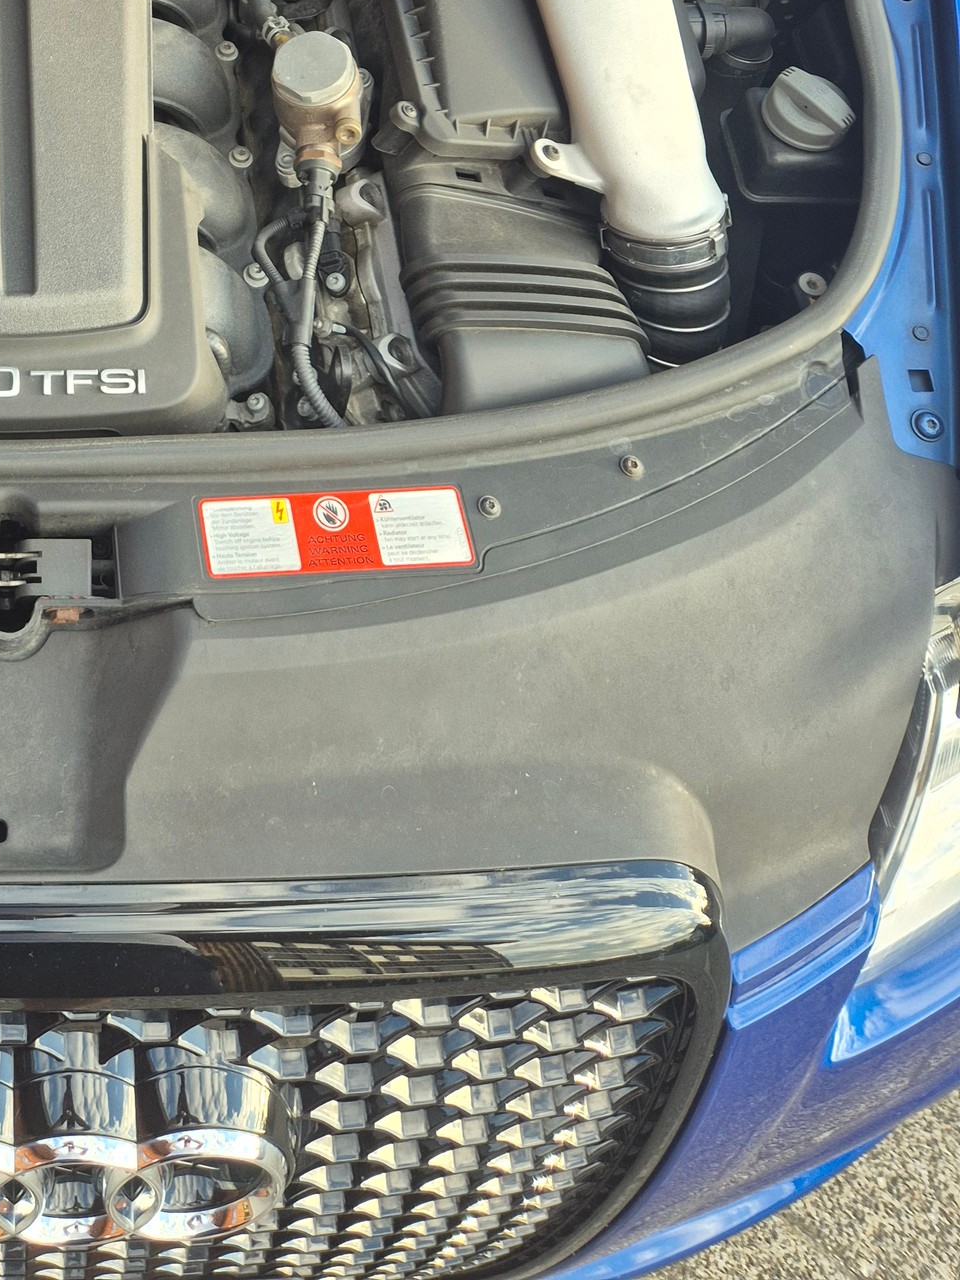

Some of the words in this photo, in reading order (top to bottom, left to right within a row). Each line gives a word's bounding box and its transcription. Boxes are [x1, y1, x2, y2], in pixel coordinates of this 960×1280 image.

[29, 368, 147, 396] TFSI
[308, 533, 366, 544] ACHTUNG
[308, 544, 369, 555] WARNING
[308, 556, 375, 567] ATTENTION
